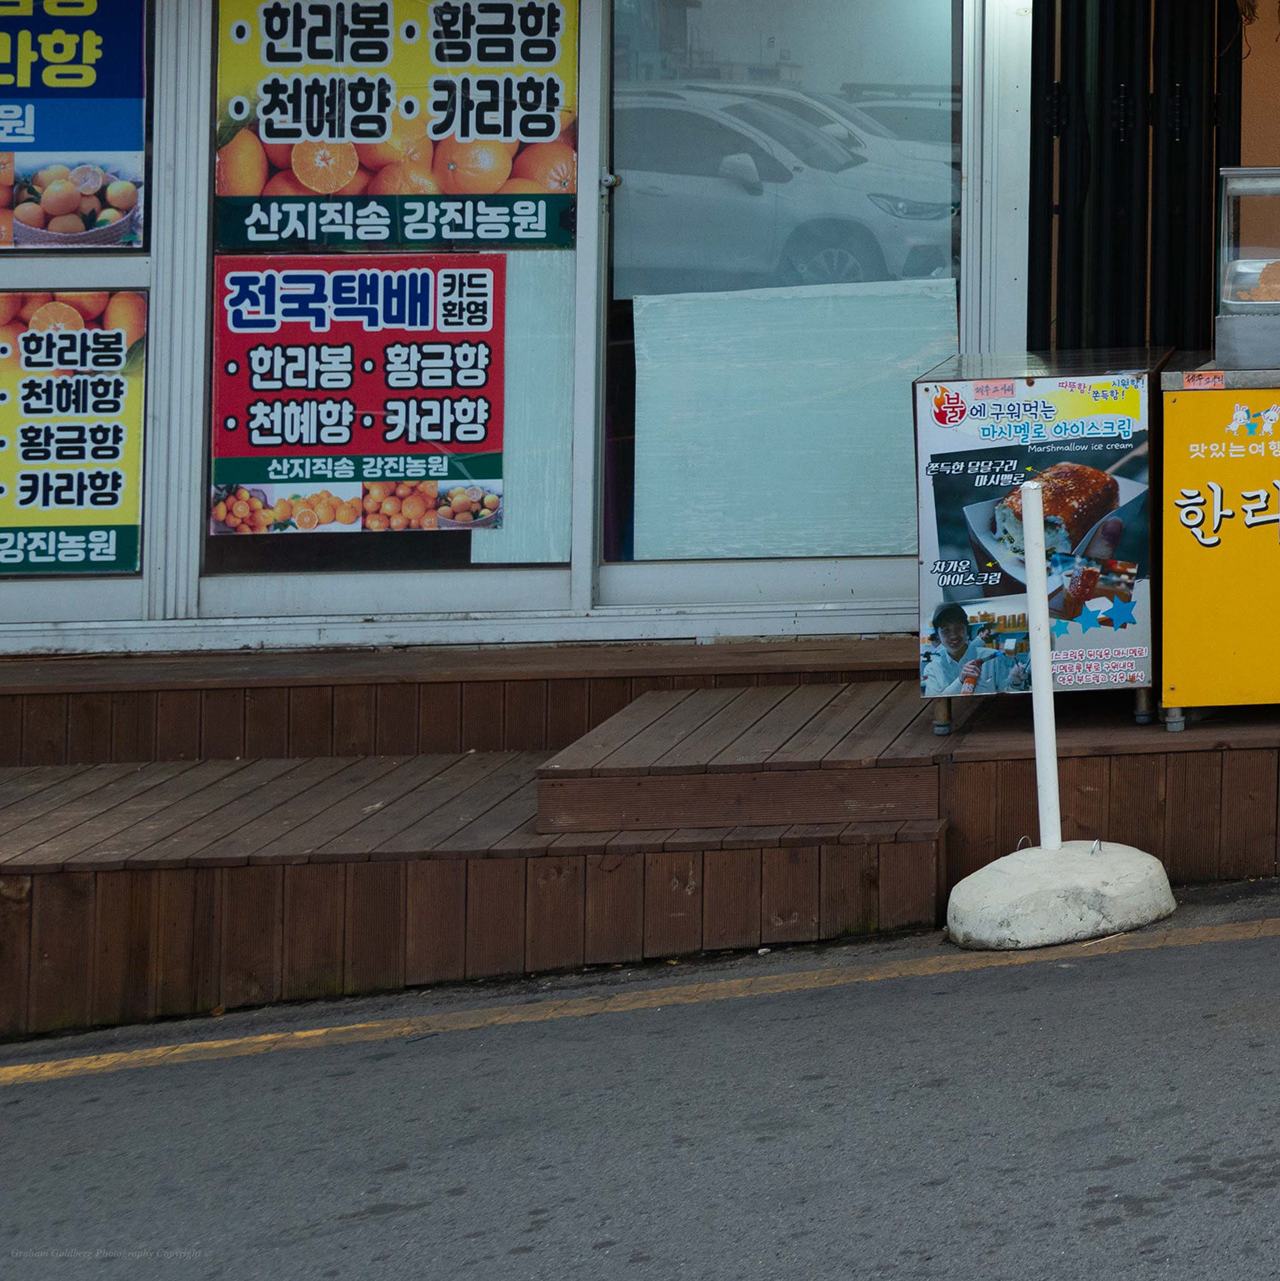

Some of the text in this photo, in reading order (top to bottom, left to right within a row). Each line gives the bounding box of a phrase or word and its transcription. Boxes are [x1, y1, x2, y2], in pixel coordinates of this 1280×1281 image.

[262, 0, 561, 65] 한라봉 황금향
[257, 77, 560, 140] 천혜향 카라향
[245, 199, 547, 242] 산지직송 강진농원
[226, 271, 432, 330] 전국택배
[442, 273, 489, 299] 카드
[441, 300, 489, 326] 환영
[21, 331, 125, 368] 한라봉
[249, 342, 489, 390] 한라봉 황금향
[21, 378, 125, 415] 천혜향
[249, 397, 489, 446] 천혜향 카라향
[981, 419, 1133, 444] 마시멜로 아이스크림
[19, 423, 124, 461] 황금향
[1028, 443, 1134, 453] Marshmallow ice cream
[267, 454, 449, 479] 산지직송 강진농원
[927, 460, 1018, 475] 쫀득한 달달구리
[974, 473, 1025, 487] 마시멜로
[18, 471, 123, 507] 카라향
[0, 529, 117, 563] 강진농원
[932, 560, 971, 573] 차가운
[938, 572, 1002, 586] 아이스크림
